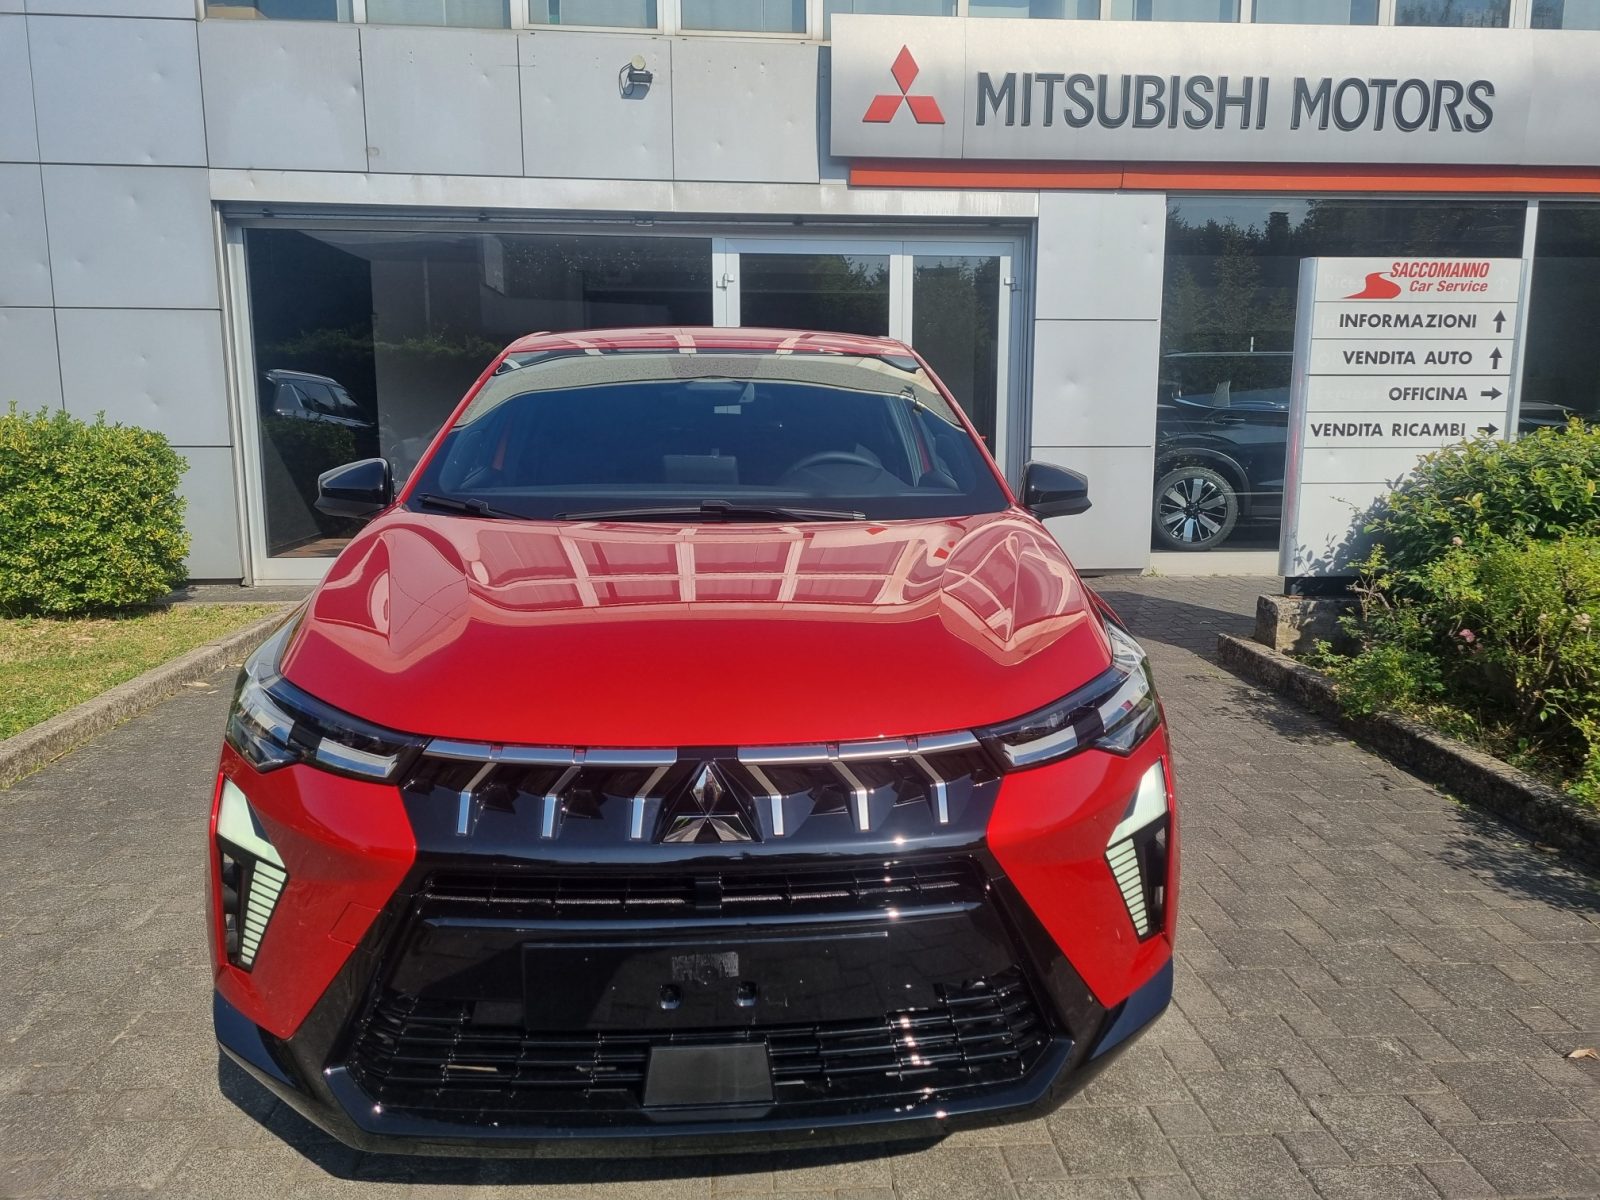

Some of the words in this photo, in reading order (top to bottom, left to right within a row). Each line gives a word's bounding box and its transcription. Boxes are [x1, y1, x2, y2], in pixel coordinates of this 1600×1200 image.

[976, 71, 1270, 130] MITSUBISHI
[1291, 78, 1496, 133] MOTORS
[1390, 262, 1490, 278] SACCOMANNO
[1409, 280, 1434, 292] Car
[1436, 280, 1488, 292] Service
[1339, 313, 1477, 328] INFORMAZIONI
[1343, 351, 1416, 365] VENDITA
[1424, 351, 1473, 365] AUTO
[1388, 387, 1468, 401] OFFICINA
[1310, 423, 1383, 437] VENDITA
[1391, 423, 1466, 437] RICAMBI
